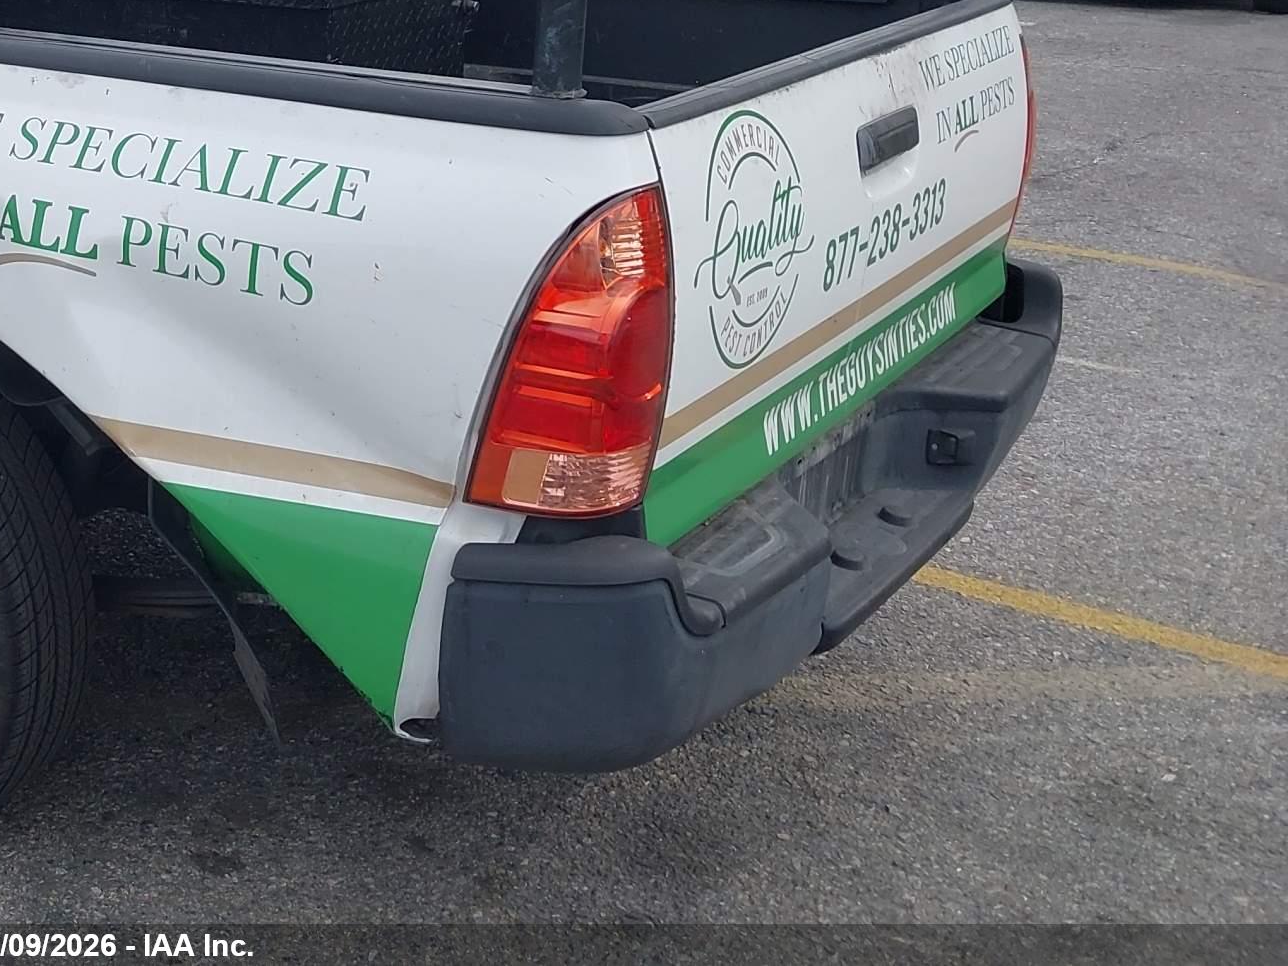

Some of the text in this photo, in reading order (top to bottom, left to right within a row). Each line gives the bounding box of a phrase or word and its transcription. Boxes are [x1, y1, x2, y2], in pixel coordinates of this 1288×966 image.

[918, 25, 1015, 91] WE SPECIALIZE
[716, 123, 781, 185] COMMERCIAL
[935, 76, 1015, 145] IN ALL PESTS
[9, 116, 371, 222] SPECIALIZE
[116, 215, 314, 307] PESTS
[694, 176, 814, 299] Quality
[823, 178, 947, 293] 877-238-3313
[720, 292, 788, 358] PEST CONTROL
[763, 282, 957, 456] WWW.THEGUYSINTIES.COM
